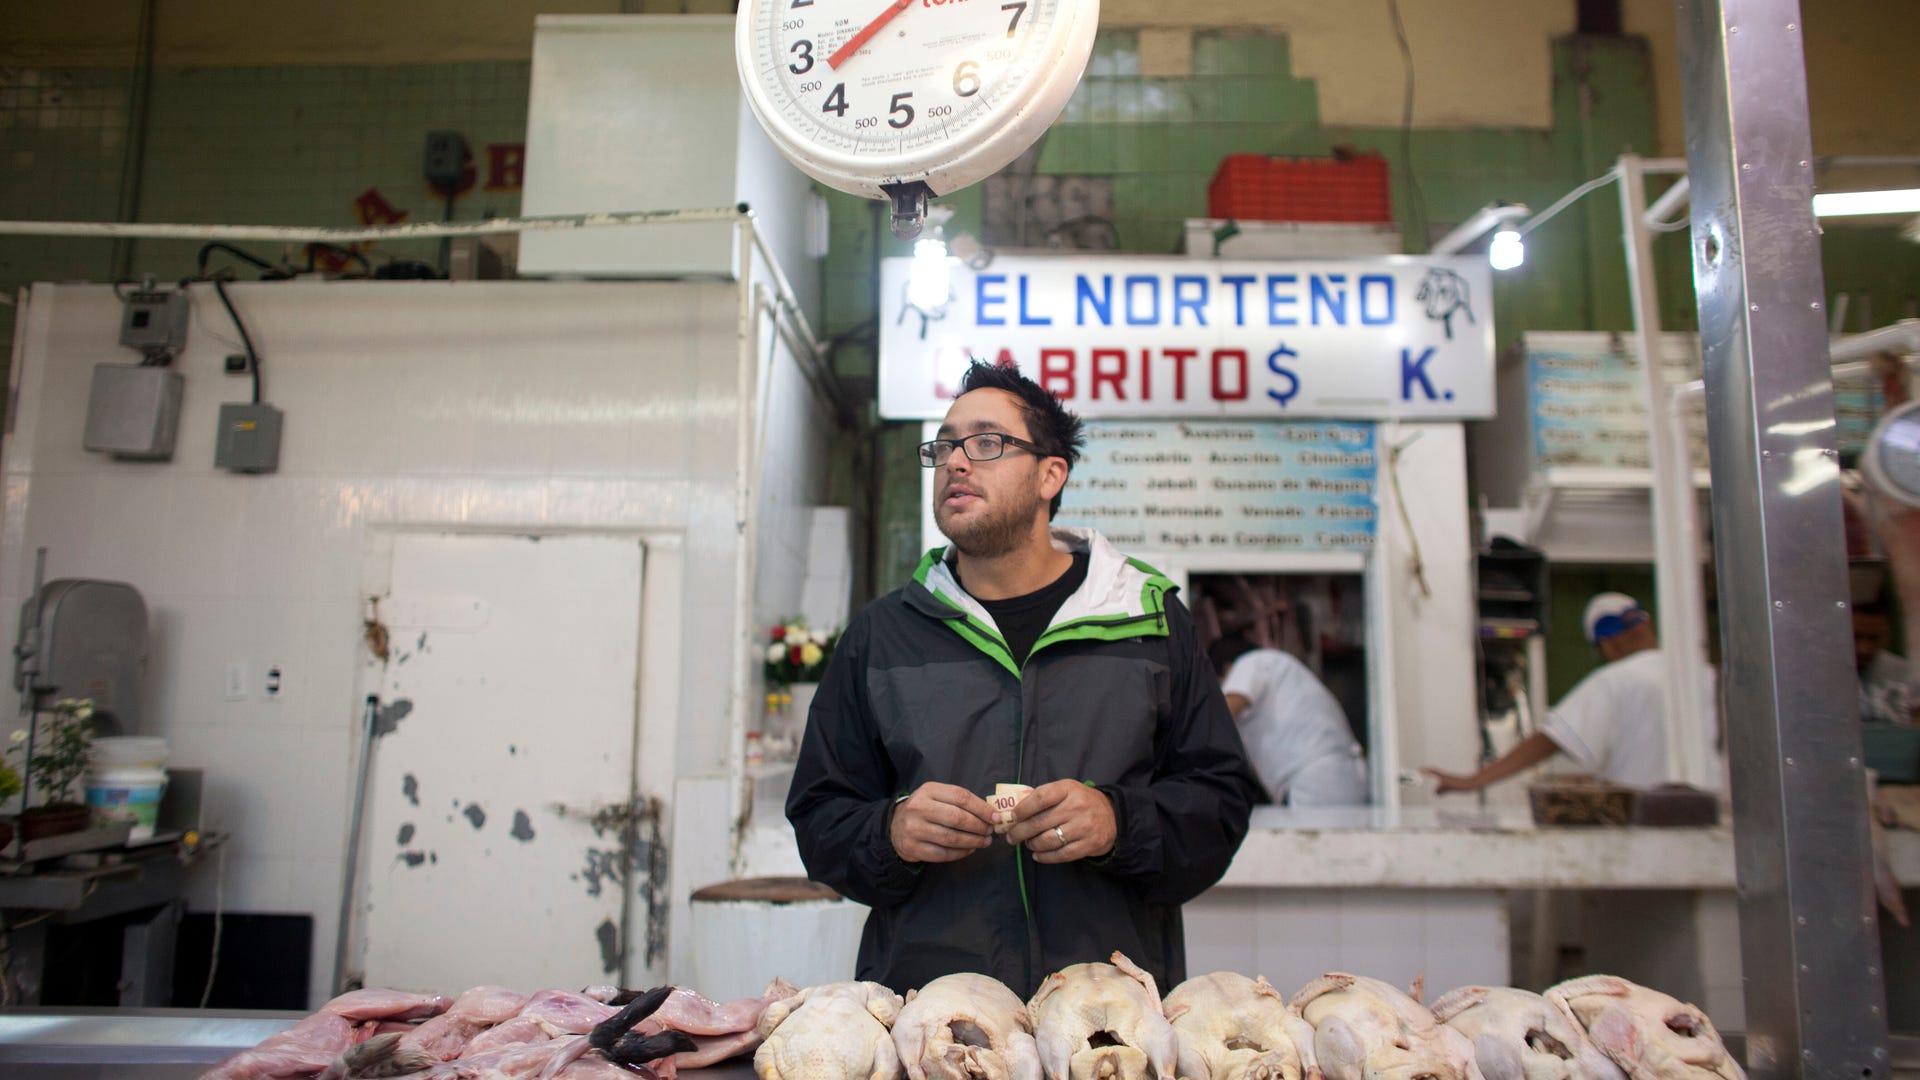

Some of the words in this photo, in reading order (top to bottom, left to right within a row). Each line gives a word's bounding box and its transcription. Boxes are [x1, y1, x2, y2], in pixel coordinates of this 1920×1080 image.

[782, 19, 804, 31] 500
[1001, 1, 1027, 38] 7
[788, 39, 814, 75] 3
[986, 49, 1011, 62] 500
[800, 80, 822, 93] 500
[953, 60, 981, 97] 6
[822, 82, 849, 118] 4
[888, 91, 915, 129] 5
[927, 105, 952, 119] 500
[855, 116, 878, 130] 500
[975, 274, 1053, 326] EL
[1076, 274, 1395, 326] NORTEÑO
[934, 347, 1249, 401] BRITO
[1401, 346, 1453, 401] K.
[1059, 503, 1138, 517] rrachera
[995, 796, 1015, 810] 100
